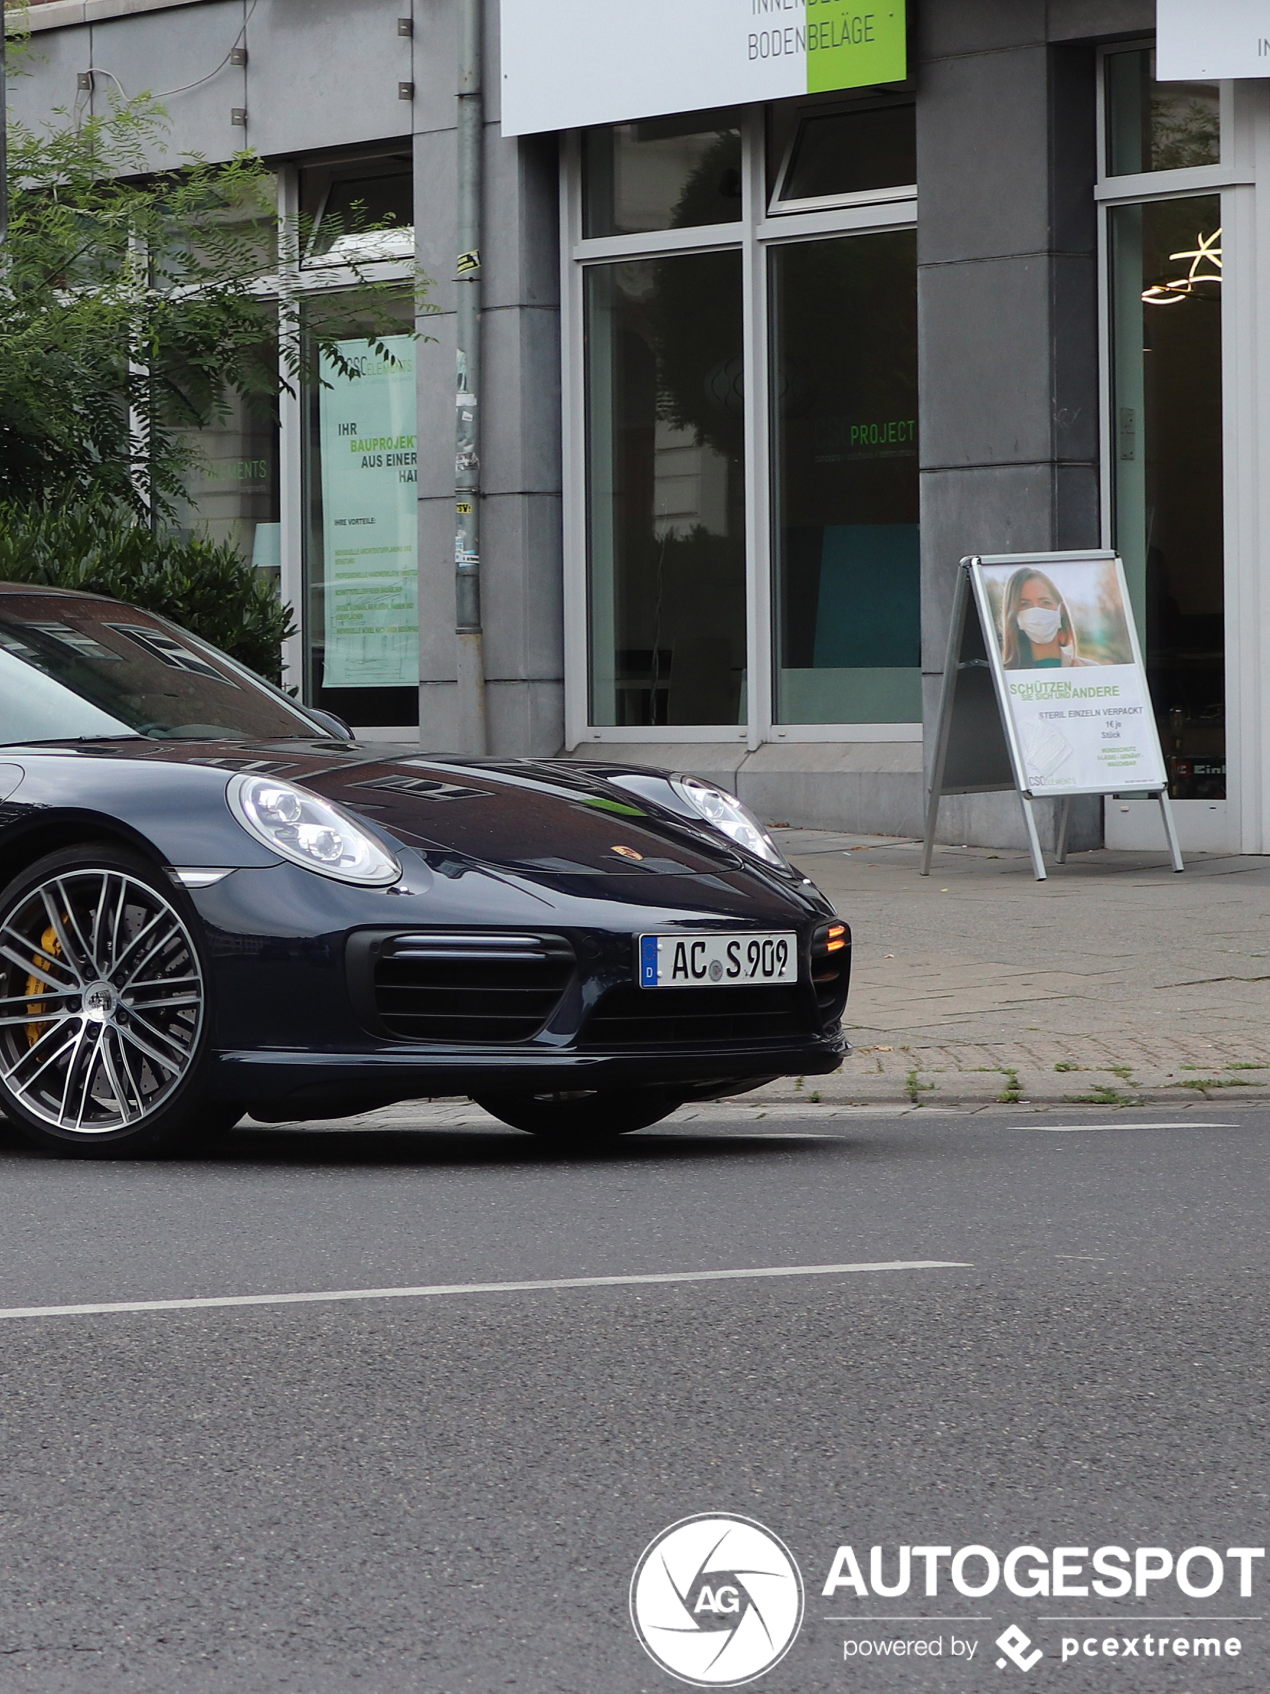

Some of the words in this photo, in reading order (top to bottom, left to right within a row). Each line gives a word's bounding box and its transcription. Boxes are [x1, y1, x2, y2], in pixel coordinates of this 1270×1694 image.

[748, 12, 875, 61] BODENBELÄGE
[338, 422, 358, 437] IHR
[850, 420, 916, 446] PROJECT
[361, 454, 383, 469] AUS
[386, 452, 418, 468] EINER
[334, 518, 347, 526] IHRE
[348, 517, 376, 526] VORTEILE:
[1010, 680, 1072, 696] SCHÜTZEN
[1021, 693, 1034, 701] SIE
[1035, 692, 1053, 700] SICH
[1055, 691, 1071, 699] UND
[1072, 685, 1120, 699] ANDERE
[1039, 711, 1067, 720] STERIL
[1068, 708, 1101, 718] EINZELN
[1102, 706, 1144, 717] VERPACKT
[1101, 731, 1121, 739] Stück
[645, 966, 654, 979] D
[671, 941, 707, 979] AC
